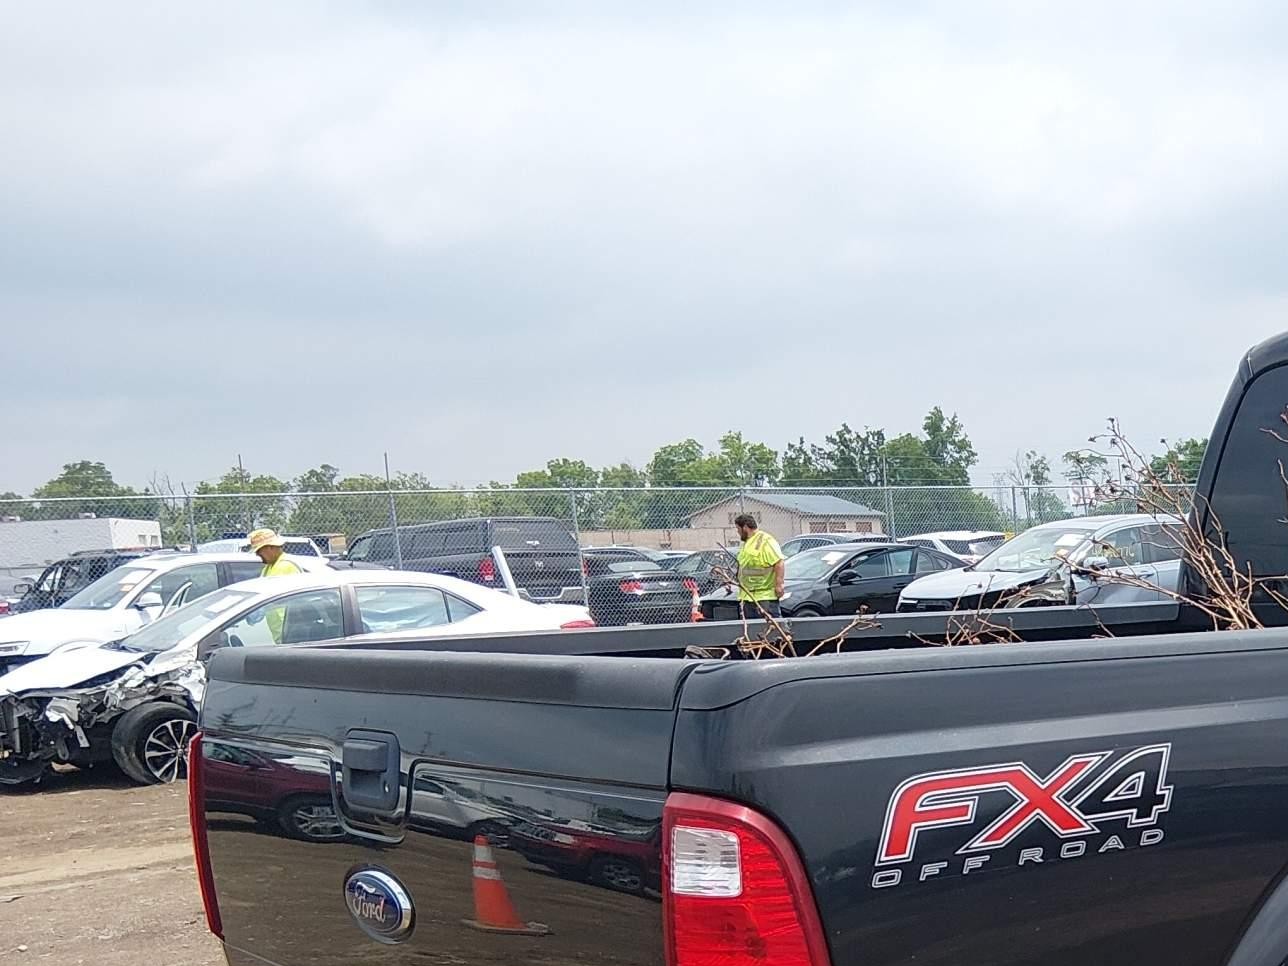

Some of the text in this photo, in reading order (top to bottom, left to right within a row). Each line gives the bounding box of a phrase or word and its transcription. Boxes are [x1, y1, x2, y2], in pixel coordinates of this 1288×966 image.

[875, 742, 1174, 866] FX4
[871, 828, 1165, 888] OFF ROAD
[352, 881, 386, 923] Ford
